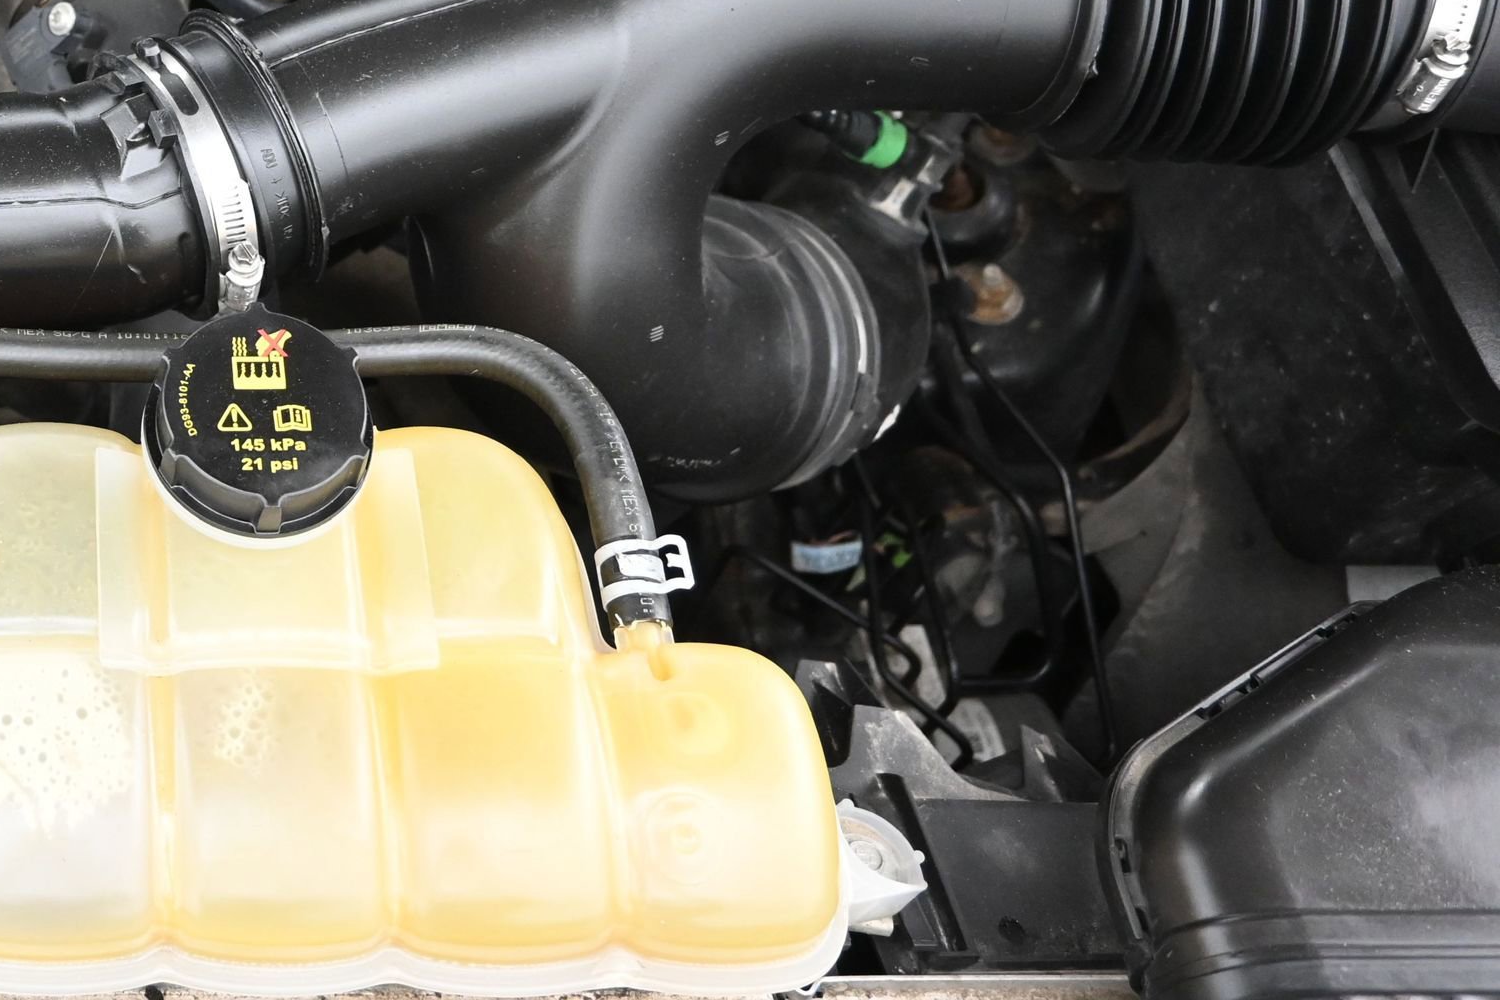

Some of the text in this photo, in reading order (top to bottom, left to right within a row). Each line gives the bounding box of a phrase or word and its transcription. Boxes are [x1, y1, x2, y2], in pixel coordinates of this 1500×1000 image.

[178, 362, 197, 437] DG93-8101-AA
[230, 438, 307, 452] 145 kPa
[241, 457, 299, 473] 21 psi
[620, 489, 640, 516] MEX
